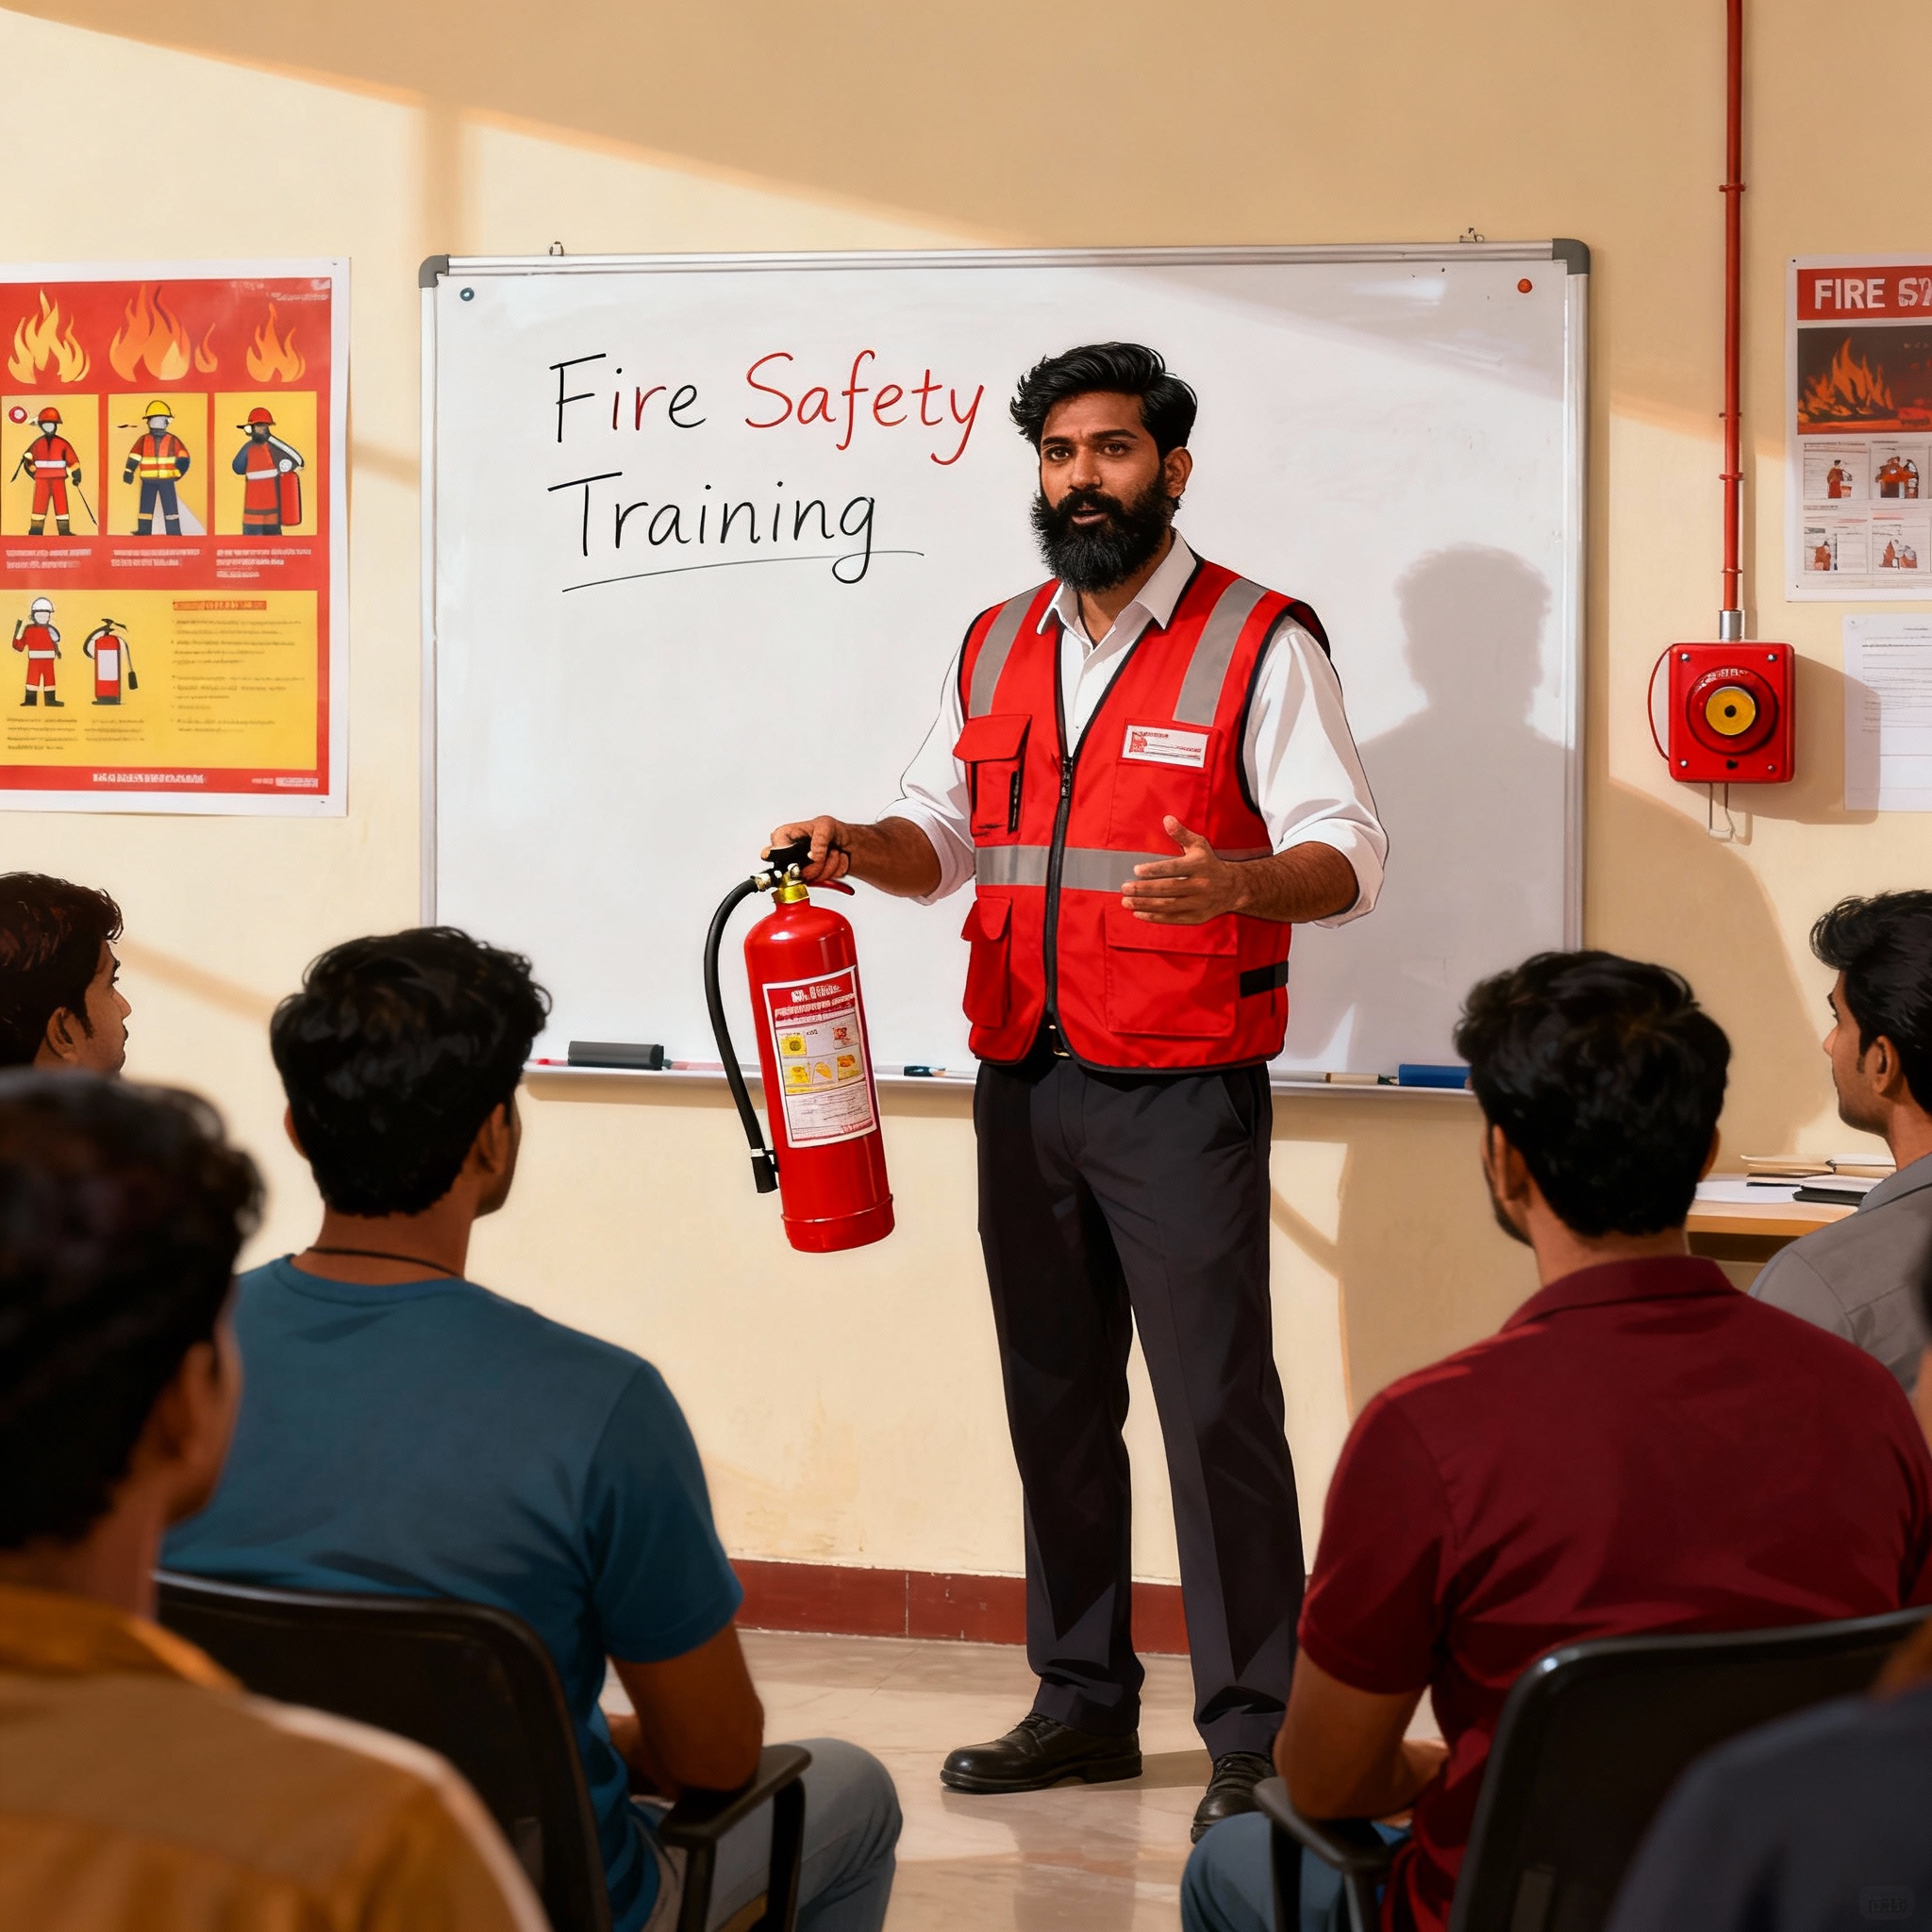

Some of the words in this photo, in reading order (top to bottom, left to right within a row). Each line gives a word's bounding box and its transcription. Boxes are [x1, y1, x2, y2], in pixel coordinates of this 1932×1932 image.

[1814, 278, 1886, 309] FIRE
[549, 352, 707, 443] Fire
[744, 349, 985, 466] Safety
[547, 471, 876, 584] Training
